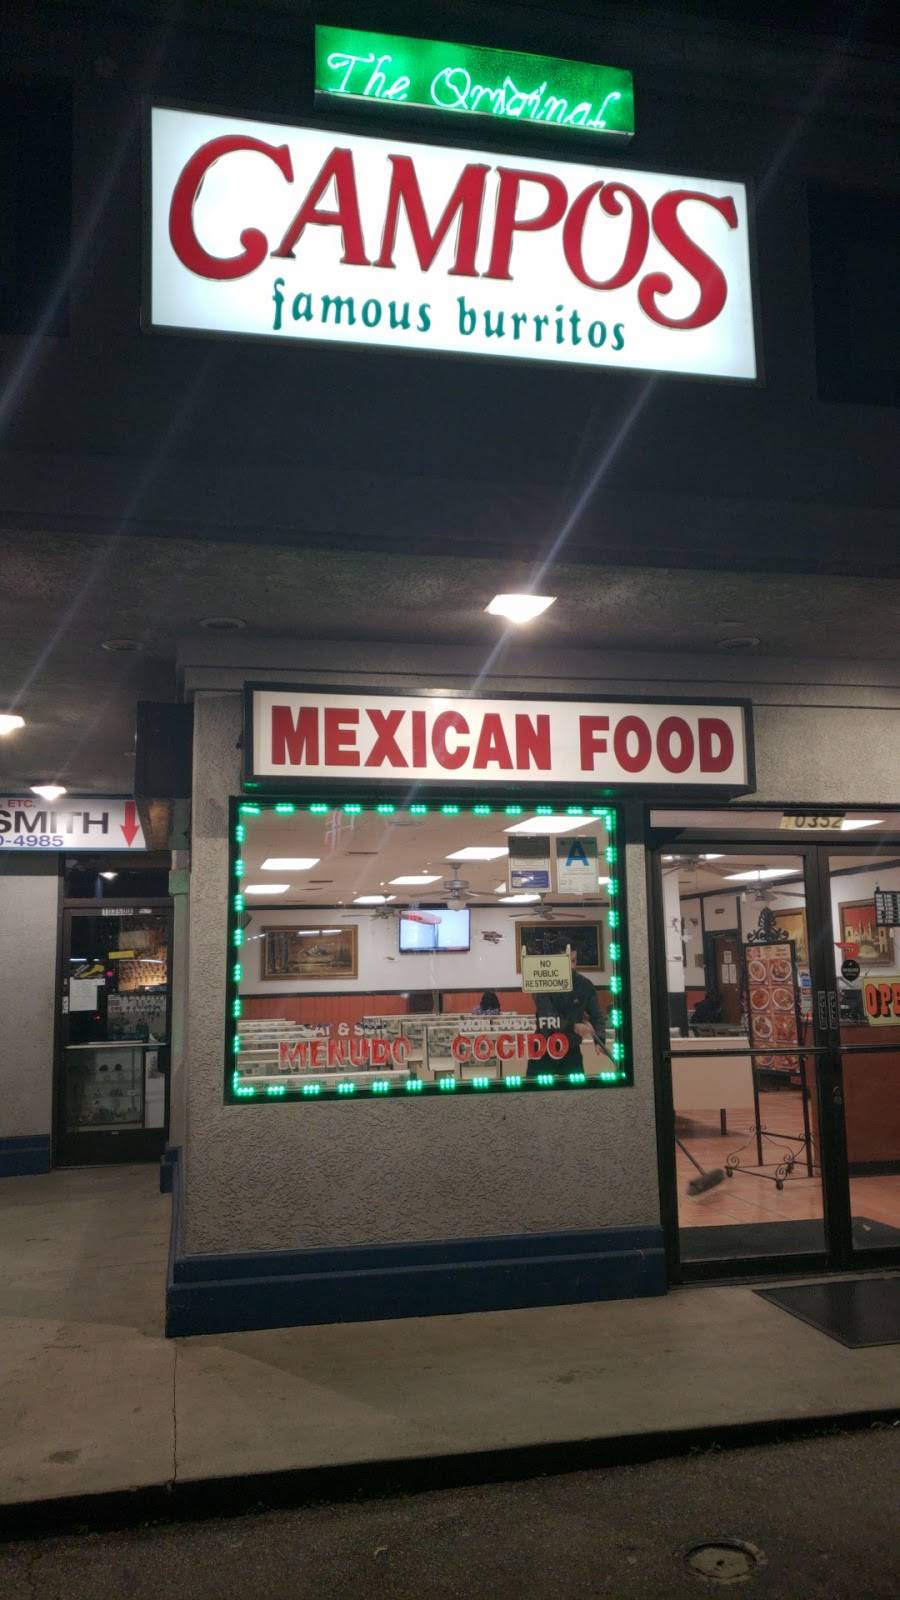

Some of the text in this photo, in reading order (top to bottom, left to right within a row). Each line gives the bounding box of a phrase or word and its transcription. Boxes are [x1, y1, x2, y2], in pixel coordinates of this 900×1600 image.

[327, 52, 411, 101] The
[168, 133, 739, 331] CAMPOS
[271, 276, 626, 352] famous burritos
[271, 705, 735, 774] MEXICAN FOOD
[7, 799, 37, 809] ETC.
[565, 840, 590, 866] A
[533, 969, 559, 978] PUBLIC
[539, 959, 552, 968] NO
[525, 979, 569, 988] RESTROOMS
[337, 1022, 350, 1036] &
[538, 1016, 561, 1029] FRI
[278, 1034, 413, 1070] MENUDO
[451, 1032, 570, 1062] COCIDO
